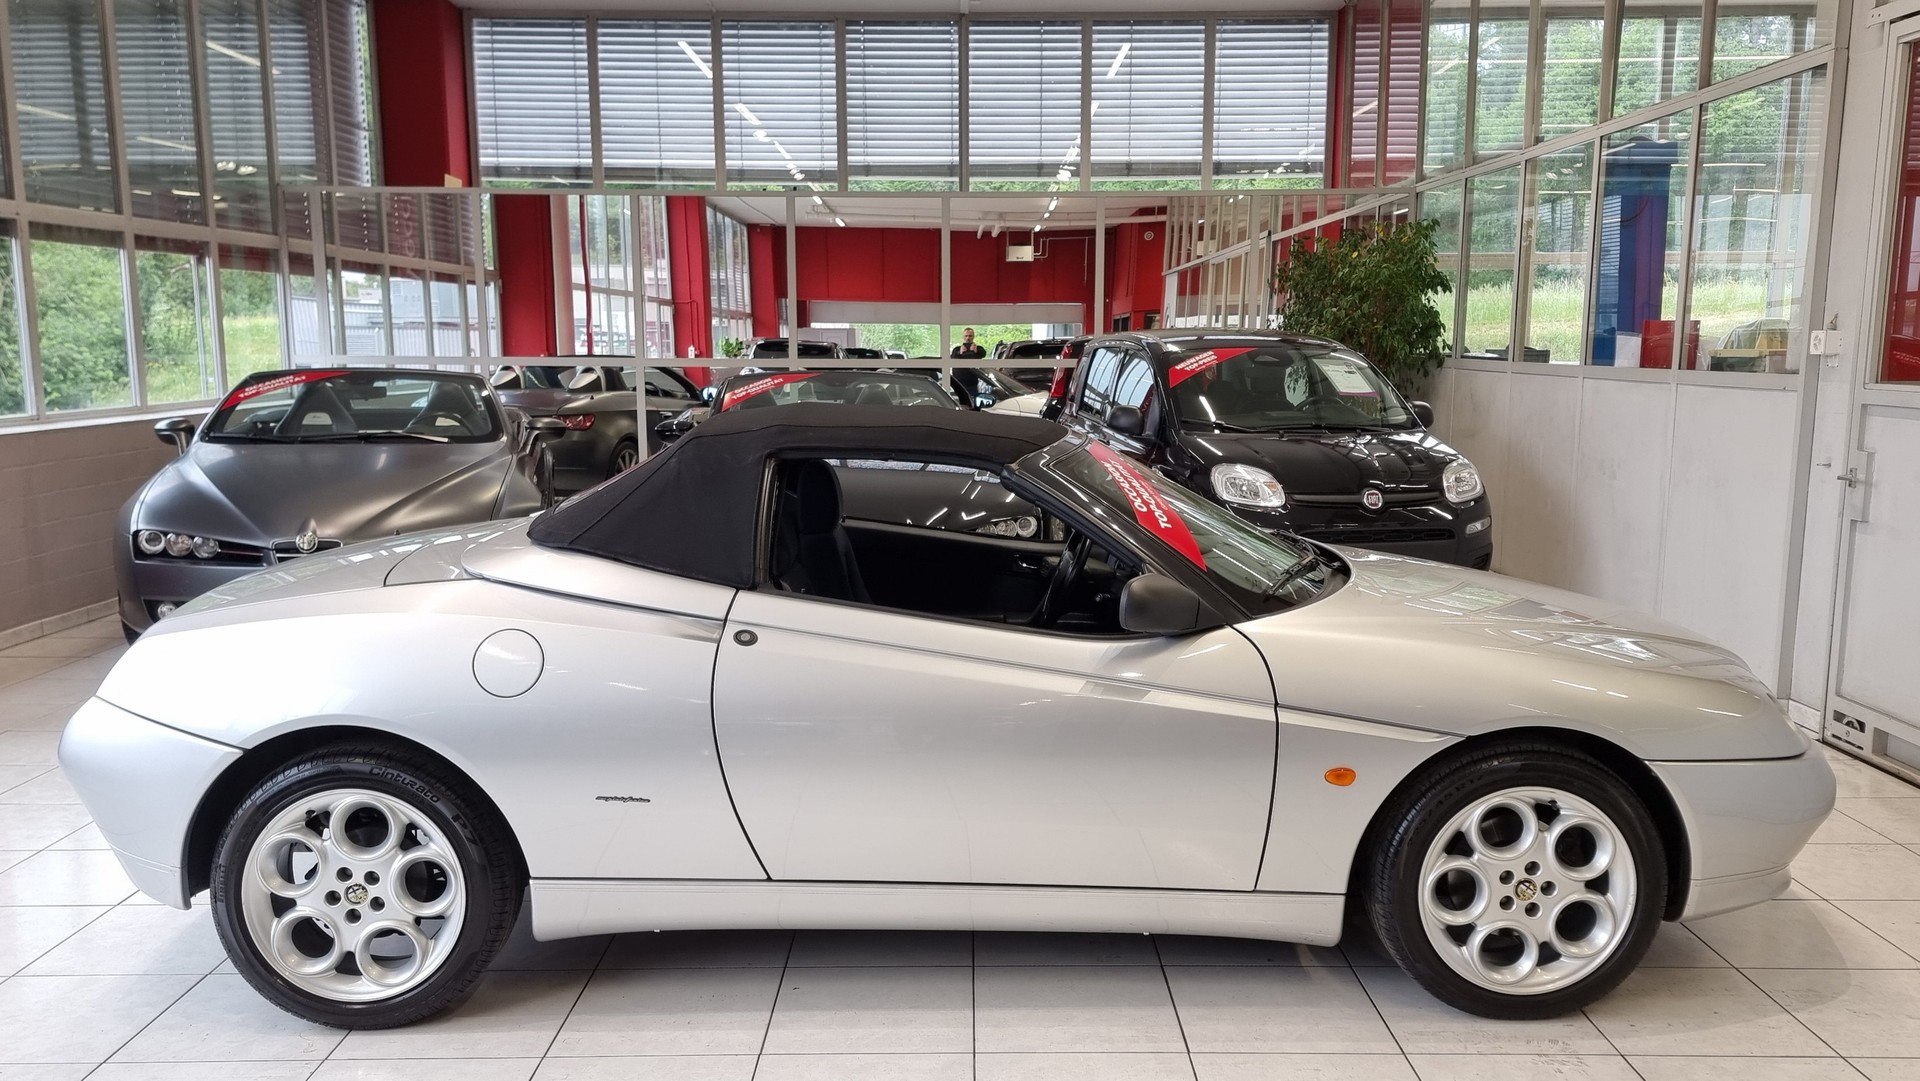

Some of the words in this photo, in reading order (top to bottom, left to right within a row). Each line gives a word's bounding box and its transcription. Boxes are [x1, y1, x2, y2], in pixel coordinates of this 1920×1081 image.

[1174, 350, 1215, 370] NEUWAGEN
[733, 378, 773, 394] OCCASION
[1100, 460, 1148, 512] OCCASION
[368, 766, 440, 803] Cinturato
